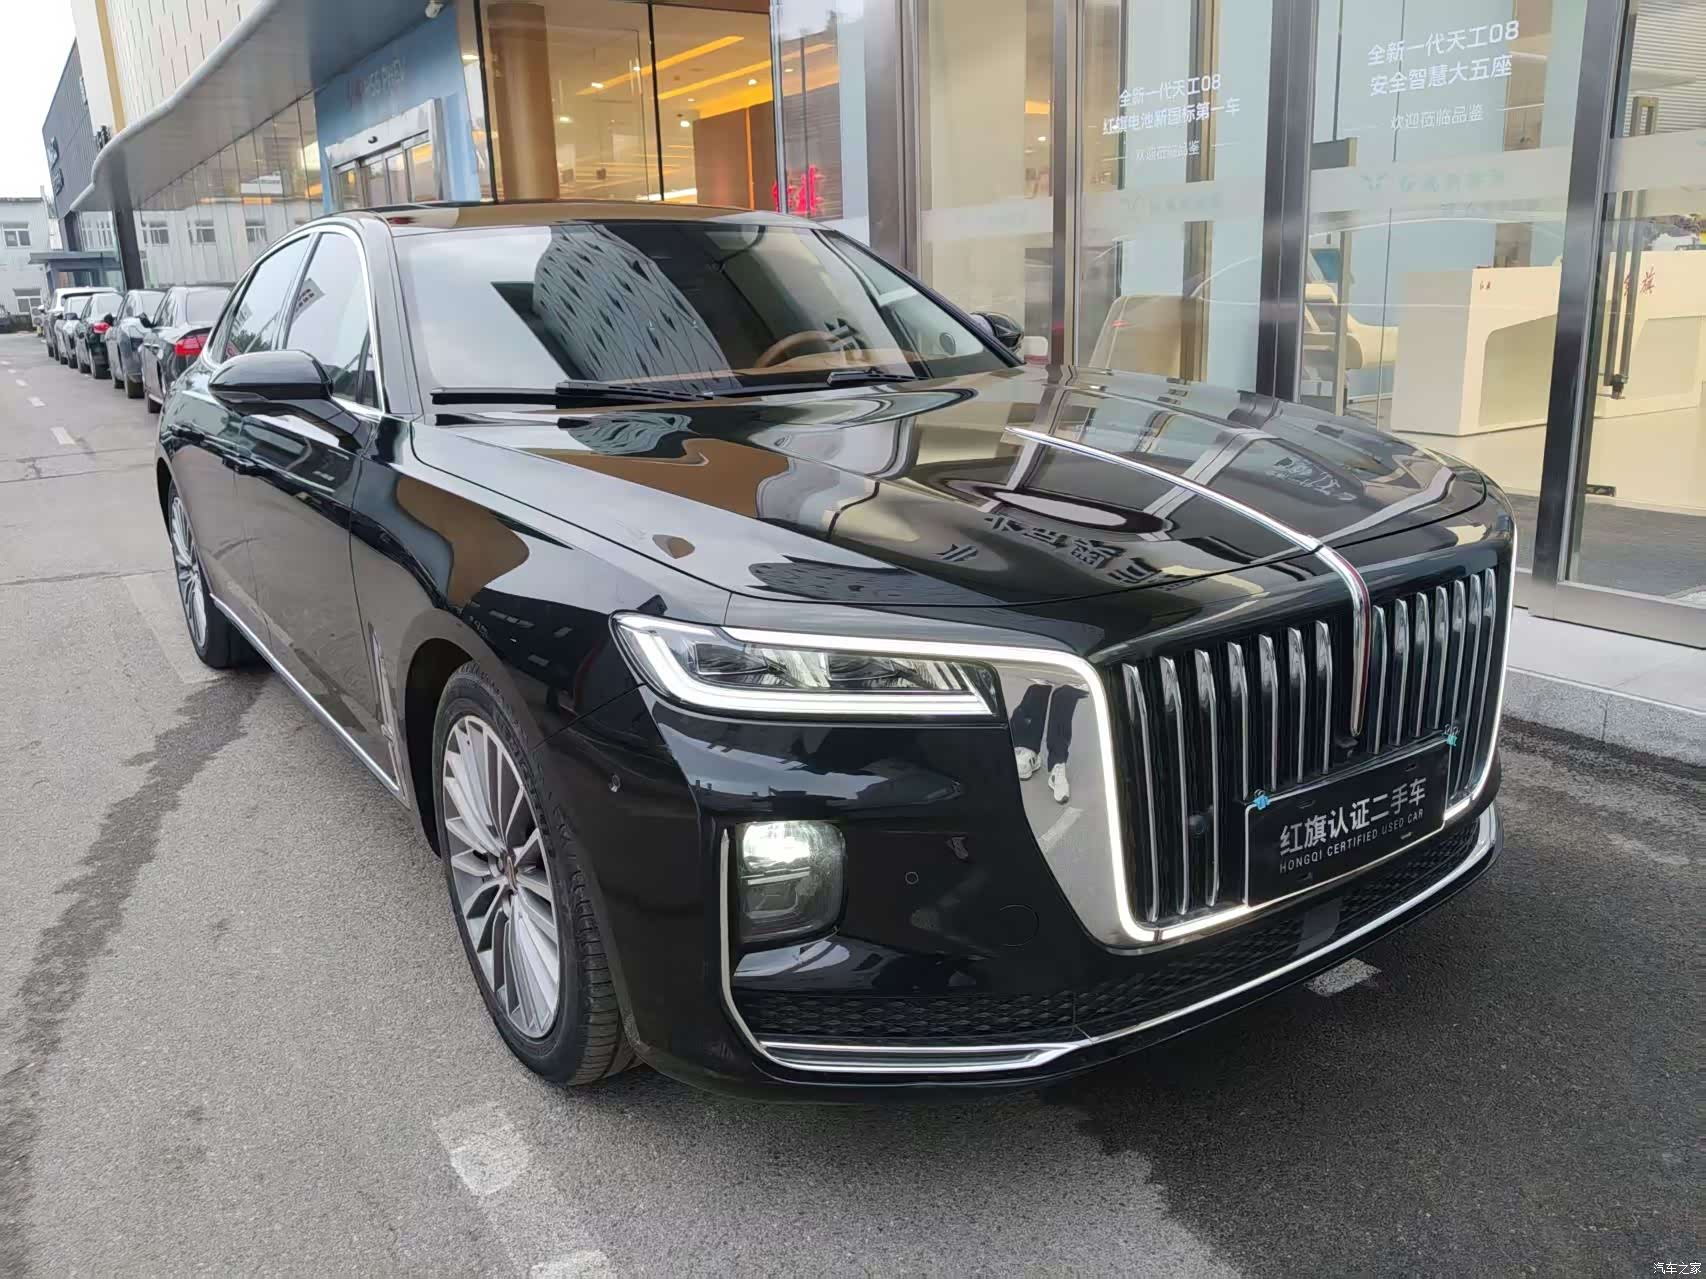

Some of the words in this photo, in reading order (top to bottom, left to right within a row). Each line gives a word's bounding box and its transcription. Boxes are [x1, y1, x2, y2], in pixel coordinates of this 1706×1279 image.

[1367, 20, 1519, 66] 全新一代天工08
[1119, 73, 1221, 108] 全新一代天工08
[1370, 54, 1513, 96] 安全智慧大五座
[1280, 777, 1427, 856] 红旗认证二手车
[1279, 850, 1322, 874] HONGQI
[1327, 828, 1378, 857] CERTIFIED
[1381, 817, 1404, 834] USED
[1408, 808, 1424, 823] CAR
